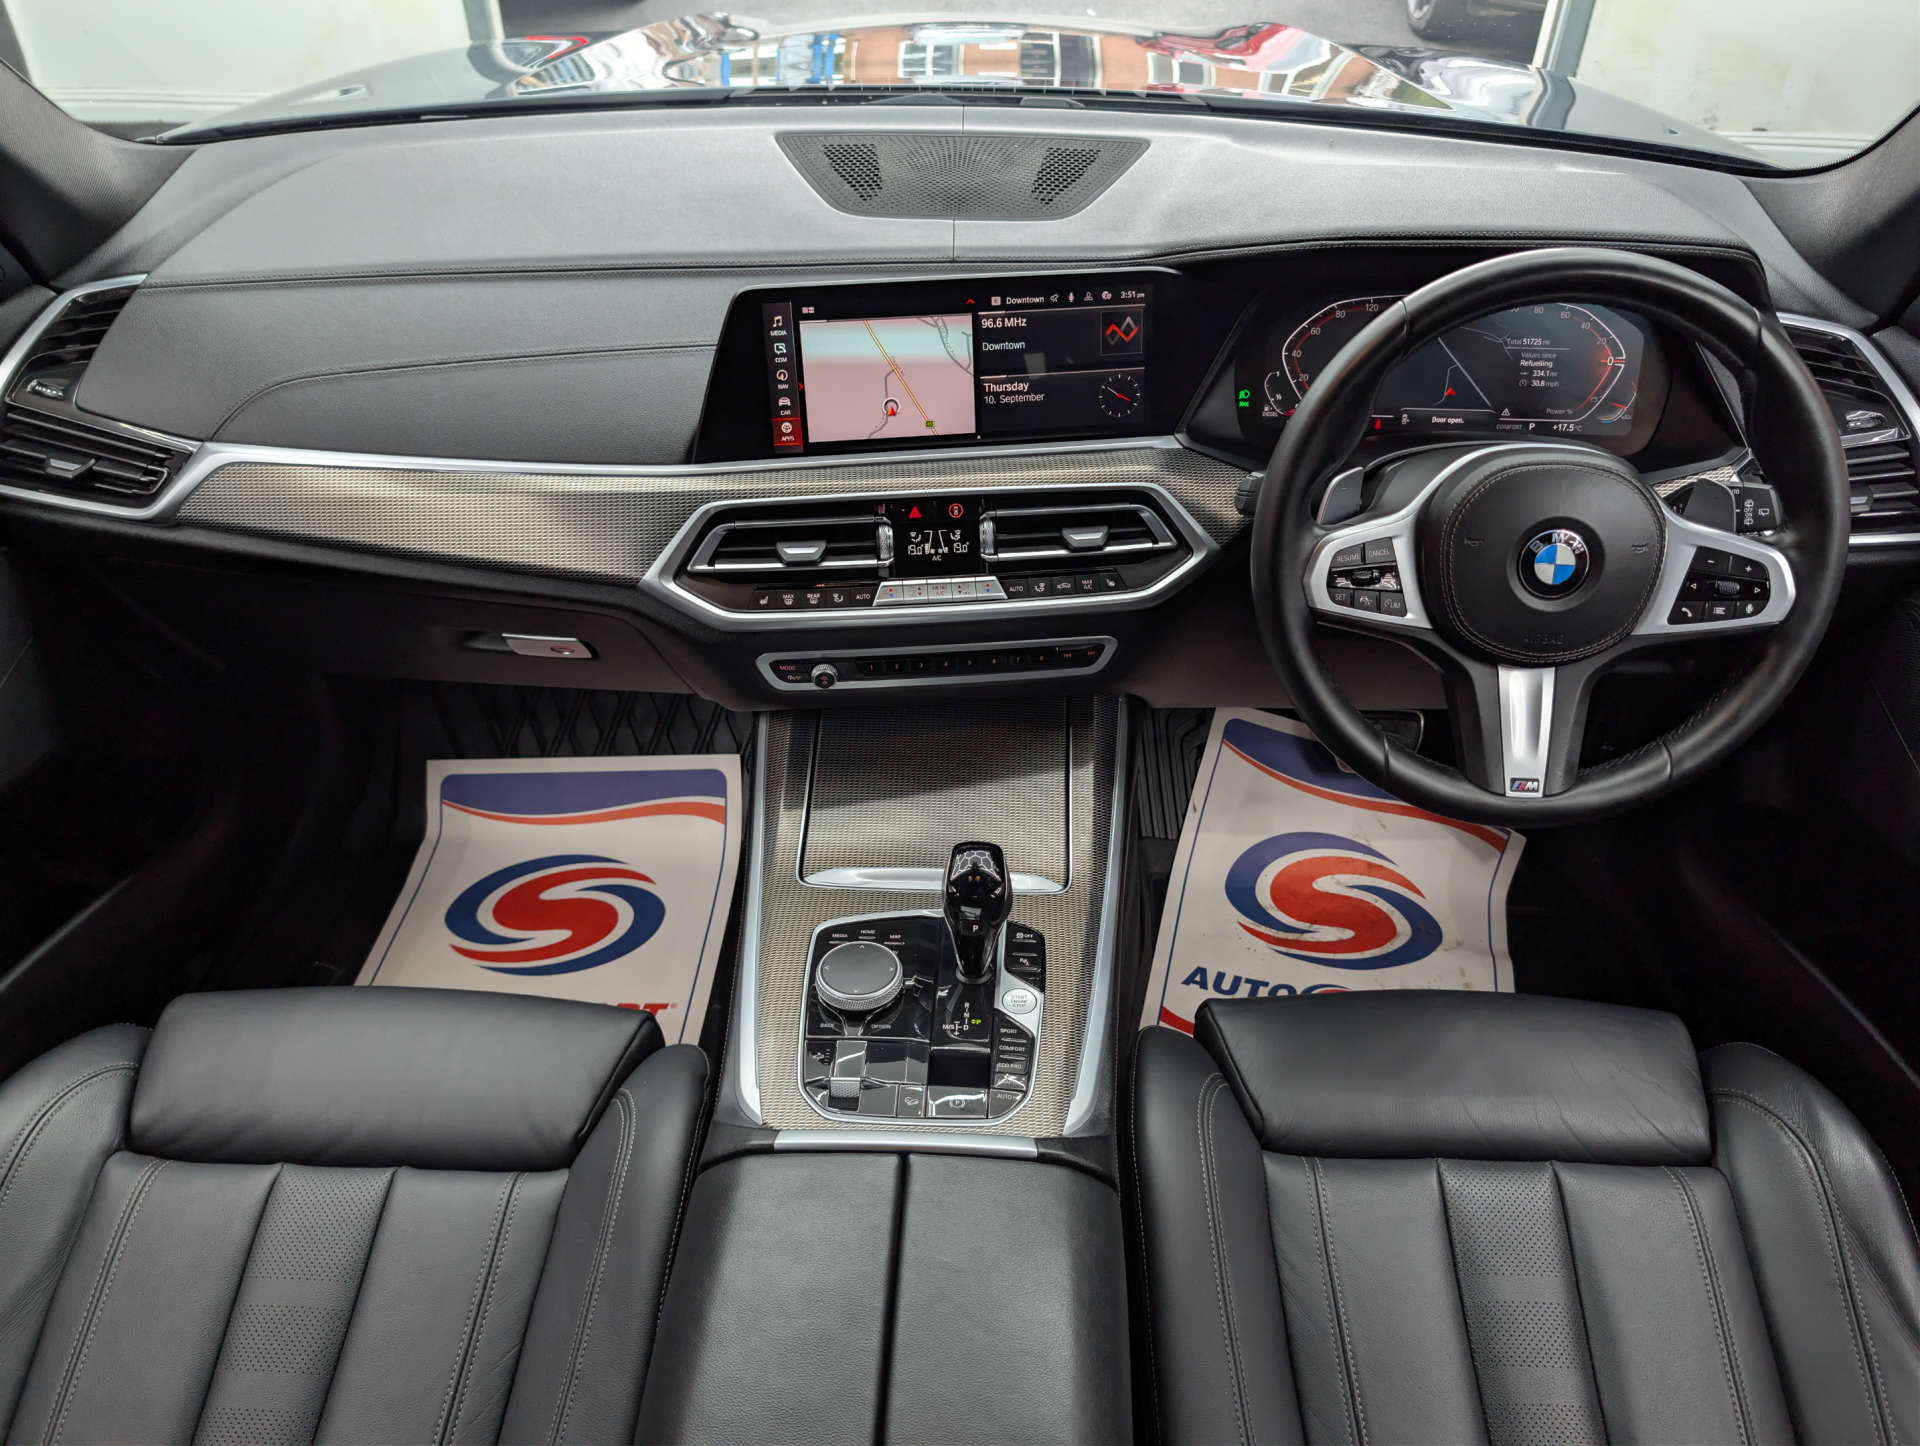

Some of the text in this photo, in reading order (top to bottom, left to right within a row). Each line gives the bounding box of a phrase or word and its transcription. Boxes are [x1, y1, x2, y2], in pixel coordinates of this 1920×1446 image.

[1121, 291, 1136, 299] 3:51
[1006, 296, 1045, 304] Downtown
[1366, 304, 1379, 312] 120
[1336, 310, 1346, 318] 80
[981, 318, 1028, 328] 96.6 MHz
[982, 341, 1026, 351] Downtown
[1522, 338, 1542, 346] 51725
[1292, 350, 1302, 358] 40
[1520, 360, 1553, 368] Refuelling
[1299, 374, 1309, 382] 20
[984, 382, 1029, 393] Thursday
[984, 394, 1045, 404] 10. September
[1432, 416, 1447, 424] Door
[1529, 533, 1584, 554] BMW
[1336, 553, 1360, 561] RESUME
[1368, 548, 1390, 558] CANCEL
[972, 924, 979, 932] P
[1181, 966, 1352, 998] AUTO
